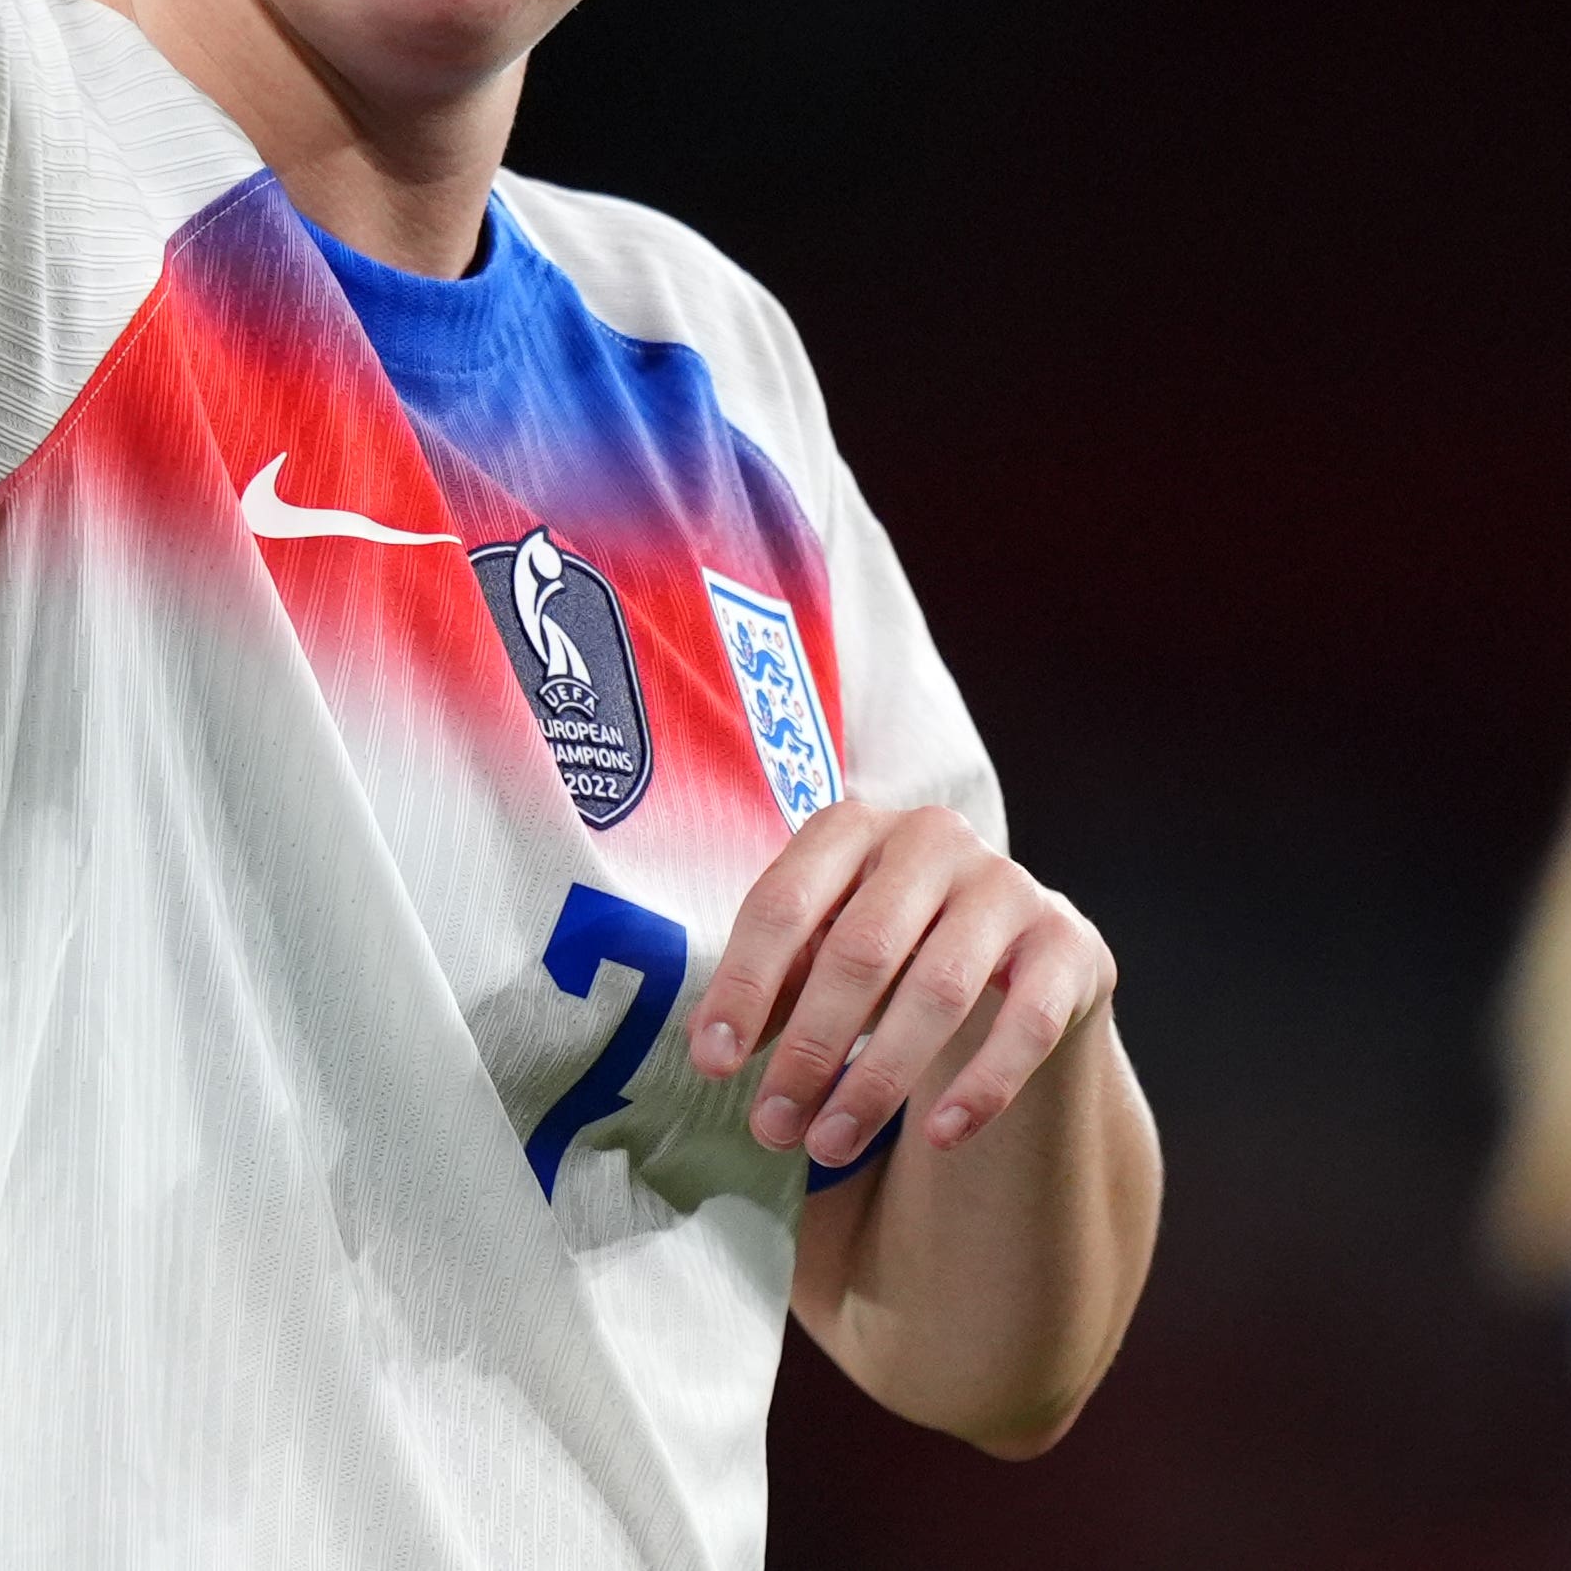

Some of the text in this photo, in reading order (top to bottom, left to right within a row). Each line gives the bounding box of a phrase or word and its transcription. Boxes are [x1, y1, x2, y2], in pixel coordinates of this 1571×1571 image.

[544, 684, 596, 712] UEFA
[538, 718, 624, 747] UROPEAN
[549, 742, 633, 772] AMPIONS
[563, 772, 621, 800] 2022
